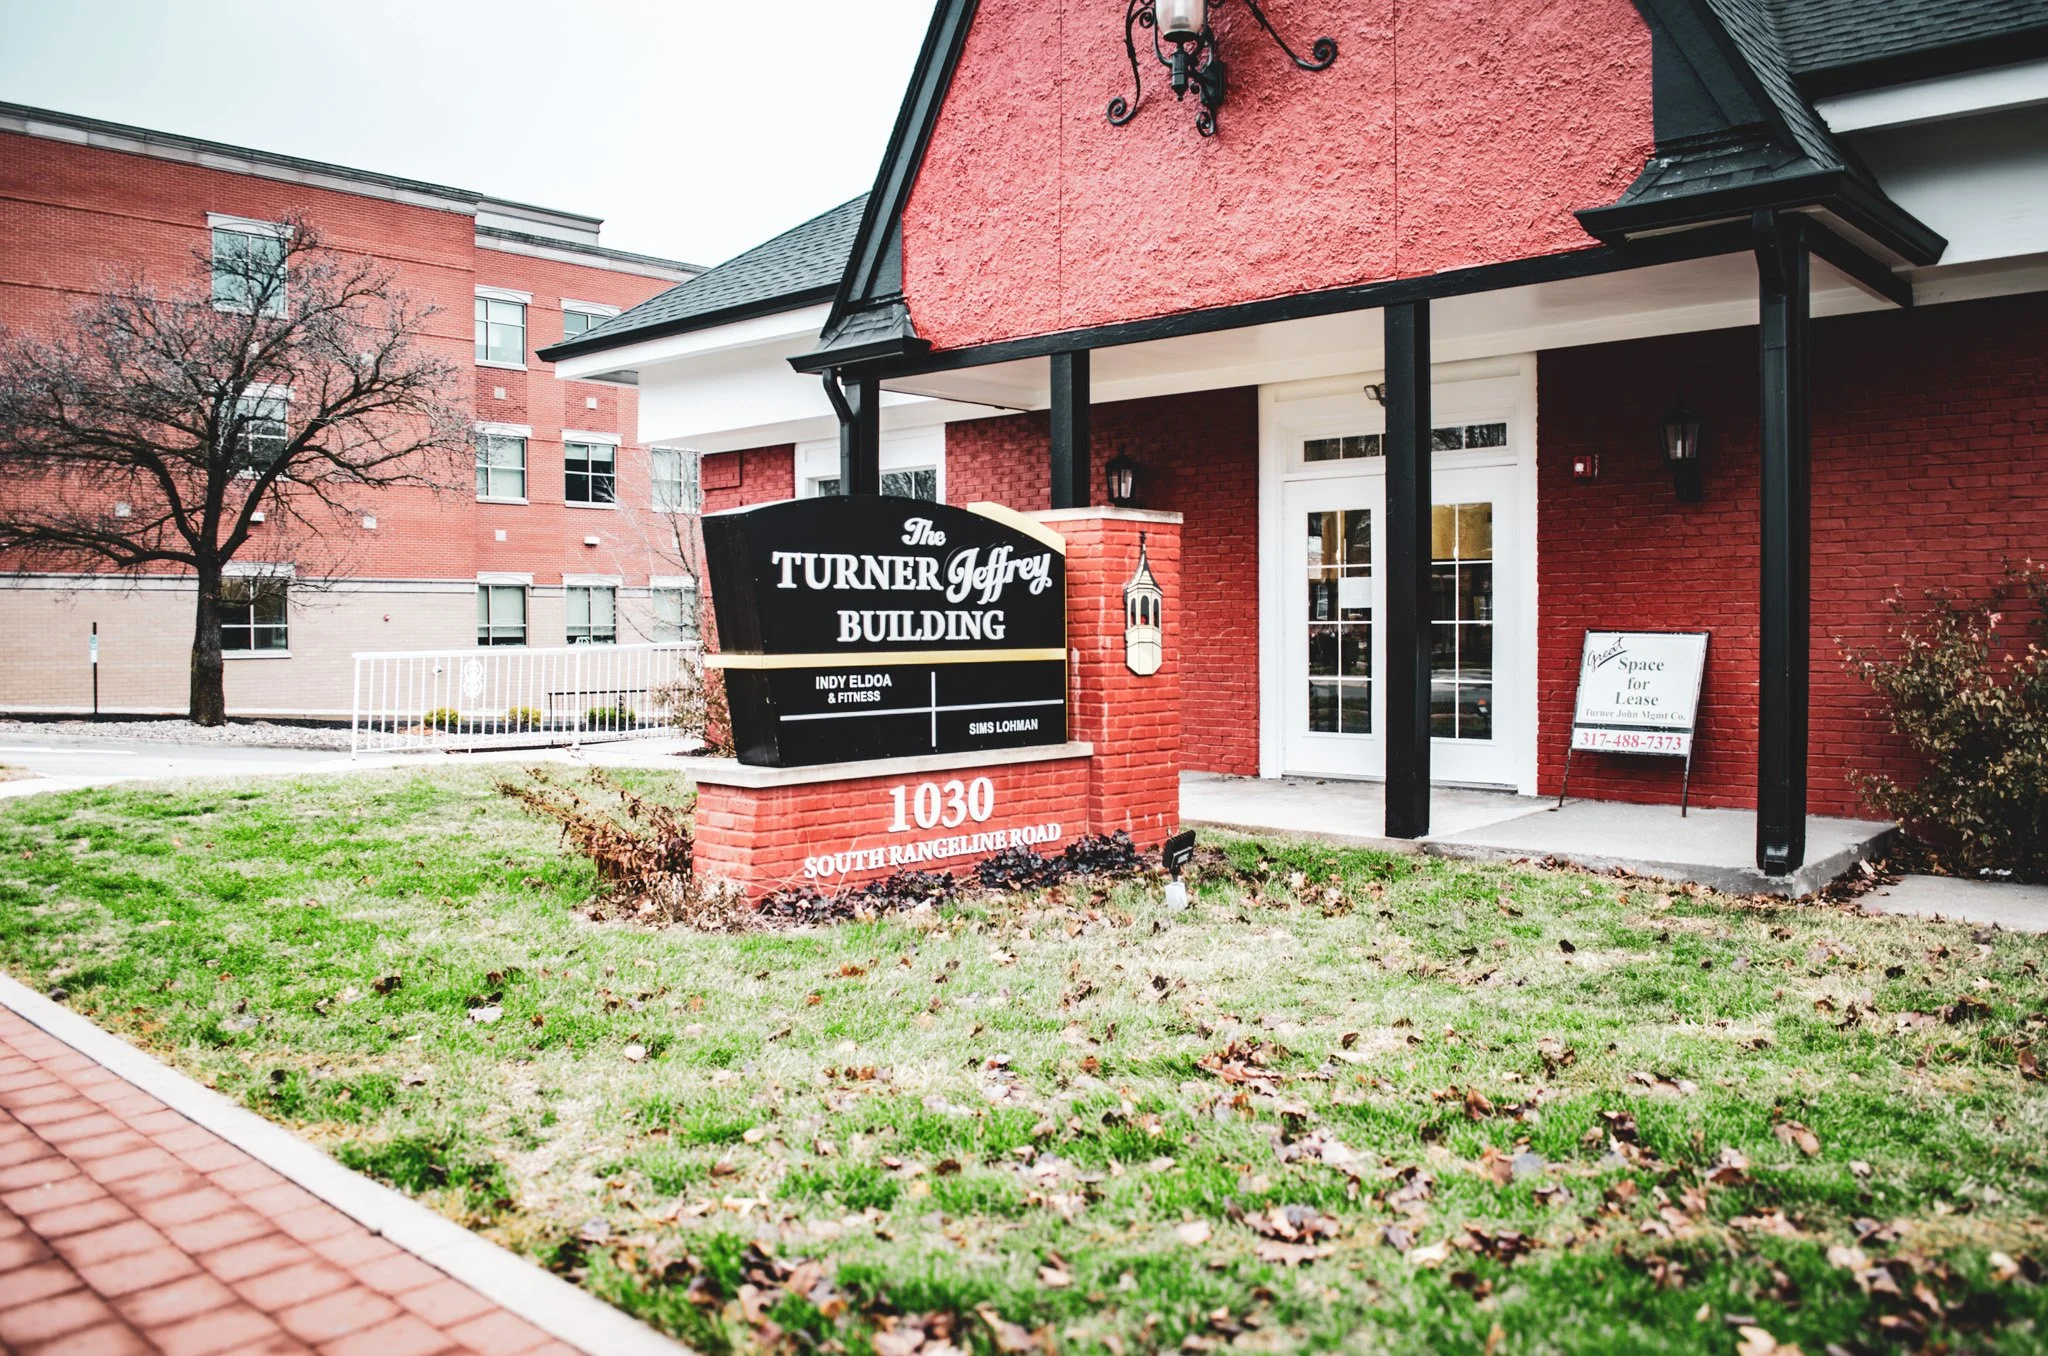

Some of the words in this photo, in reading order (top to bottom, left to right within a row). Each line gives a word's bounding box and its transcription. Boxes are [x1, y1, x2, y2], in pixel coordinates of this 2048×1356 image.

[902, 517, 947, 547] The
[772, 551, 944, 591] TURNER
[946, 545, 1053, 605] Jeffrey
[836, 610, 1006, 642] BUILDING
[1587, 636, 1625, 672] Great
[1618, 657, 1665, 674] Space
[816, 675, 846, 690] INDY
[849, 673, 892, 688] ELDOA
[1627, 677, 1651, 690] for
[827, 692, 837, 704] &
[838, 690, 881, 703] FITNESS
[1615, 692, 1660, 706] Lease
[1585, 708, 1614, 718] Turner
[1616, 709, 1638, 718] John
[1642, 711, 1668, 721] Mgmt
[1670, 713, 1686, 721] Co.
[969, 722, 994, 735] SIMS
[996, 718, 1039, 734] LOHMAN
[1580, 732, 1682, 751] 317-488-7373
[888, 777, 995, 833] 1030
[803, 847, 886, 879] SOUTH
[887, 829, 1009, 866] RANGELINE
[1009, 822, 1062, 848] ROAD
